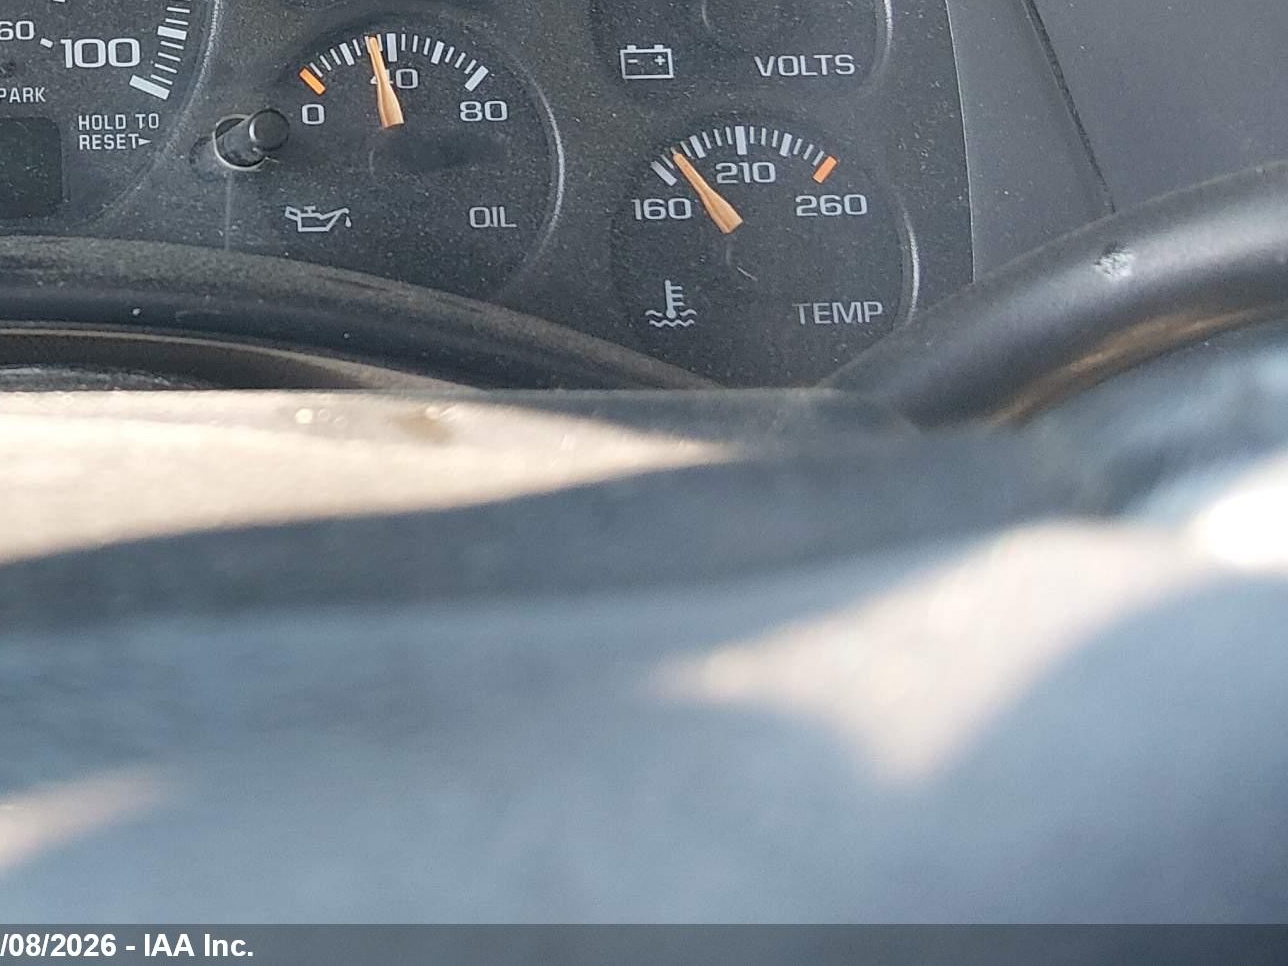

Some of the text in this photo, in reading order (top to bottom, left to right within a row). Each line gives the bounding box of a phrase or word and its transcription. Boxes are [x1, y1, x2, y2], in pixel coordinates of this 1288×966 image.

[61, 39, 140, 68] 100
[755, 55, 854, 76] VOLTS
[302, 104, 324, 124] 0
[460, 101, 507, 121] 80
[79, 114, 158, 130] HOLD TO
[80, 134, 138, 149] RESET
[715, 162, 775, 183] 210
[632, 198, 691, 219] 160
[796, 195, 867, 216] 260
[470, 207, 516, 227] OIL
[794, 302, 883, 324] TEMP
